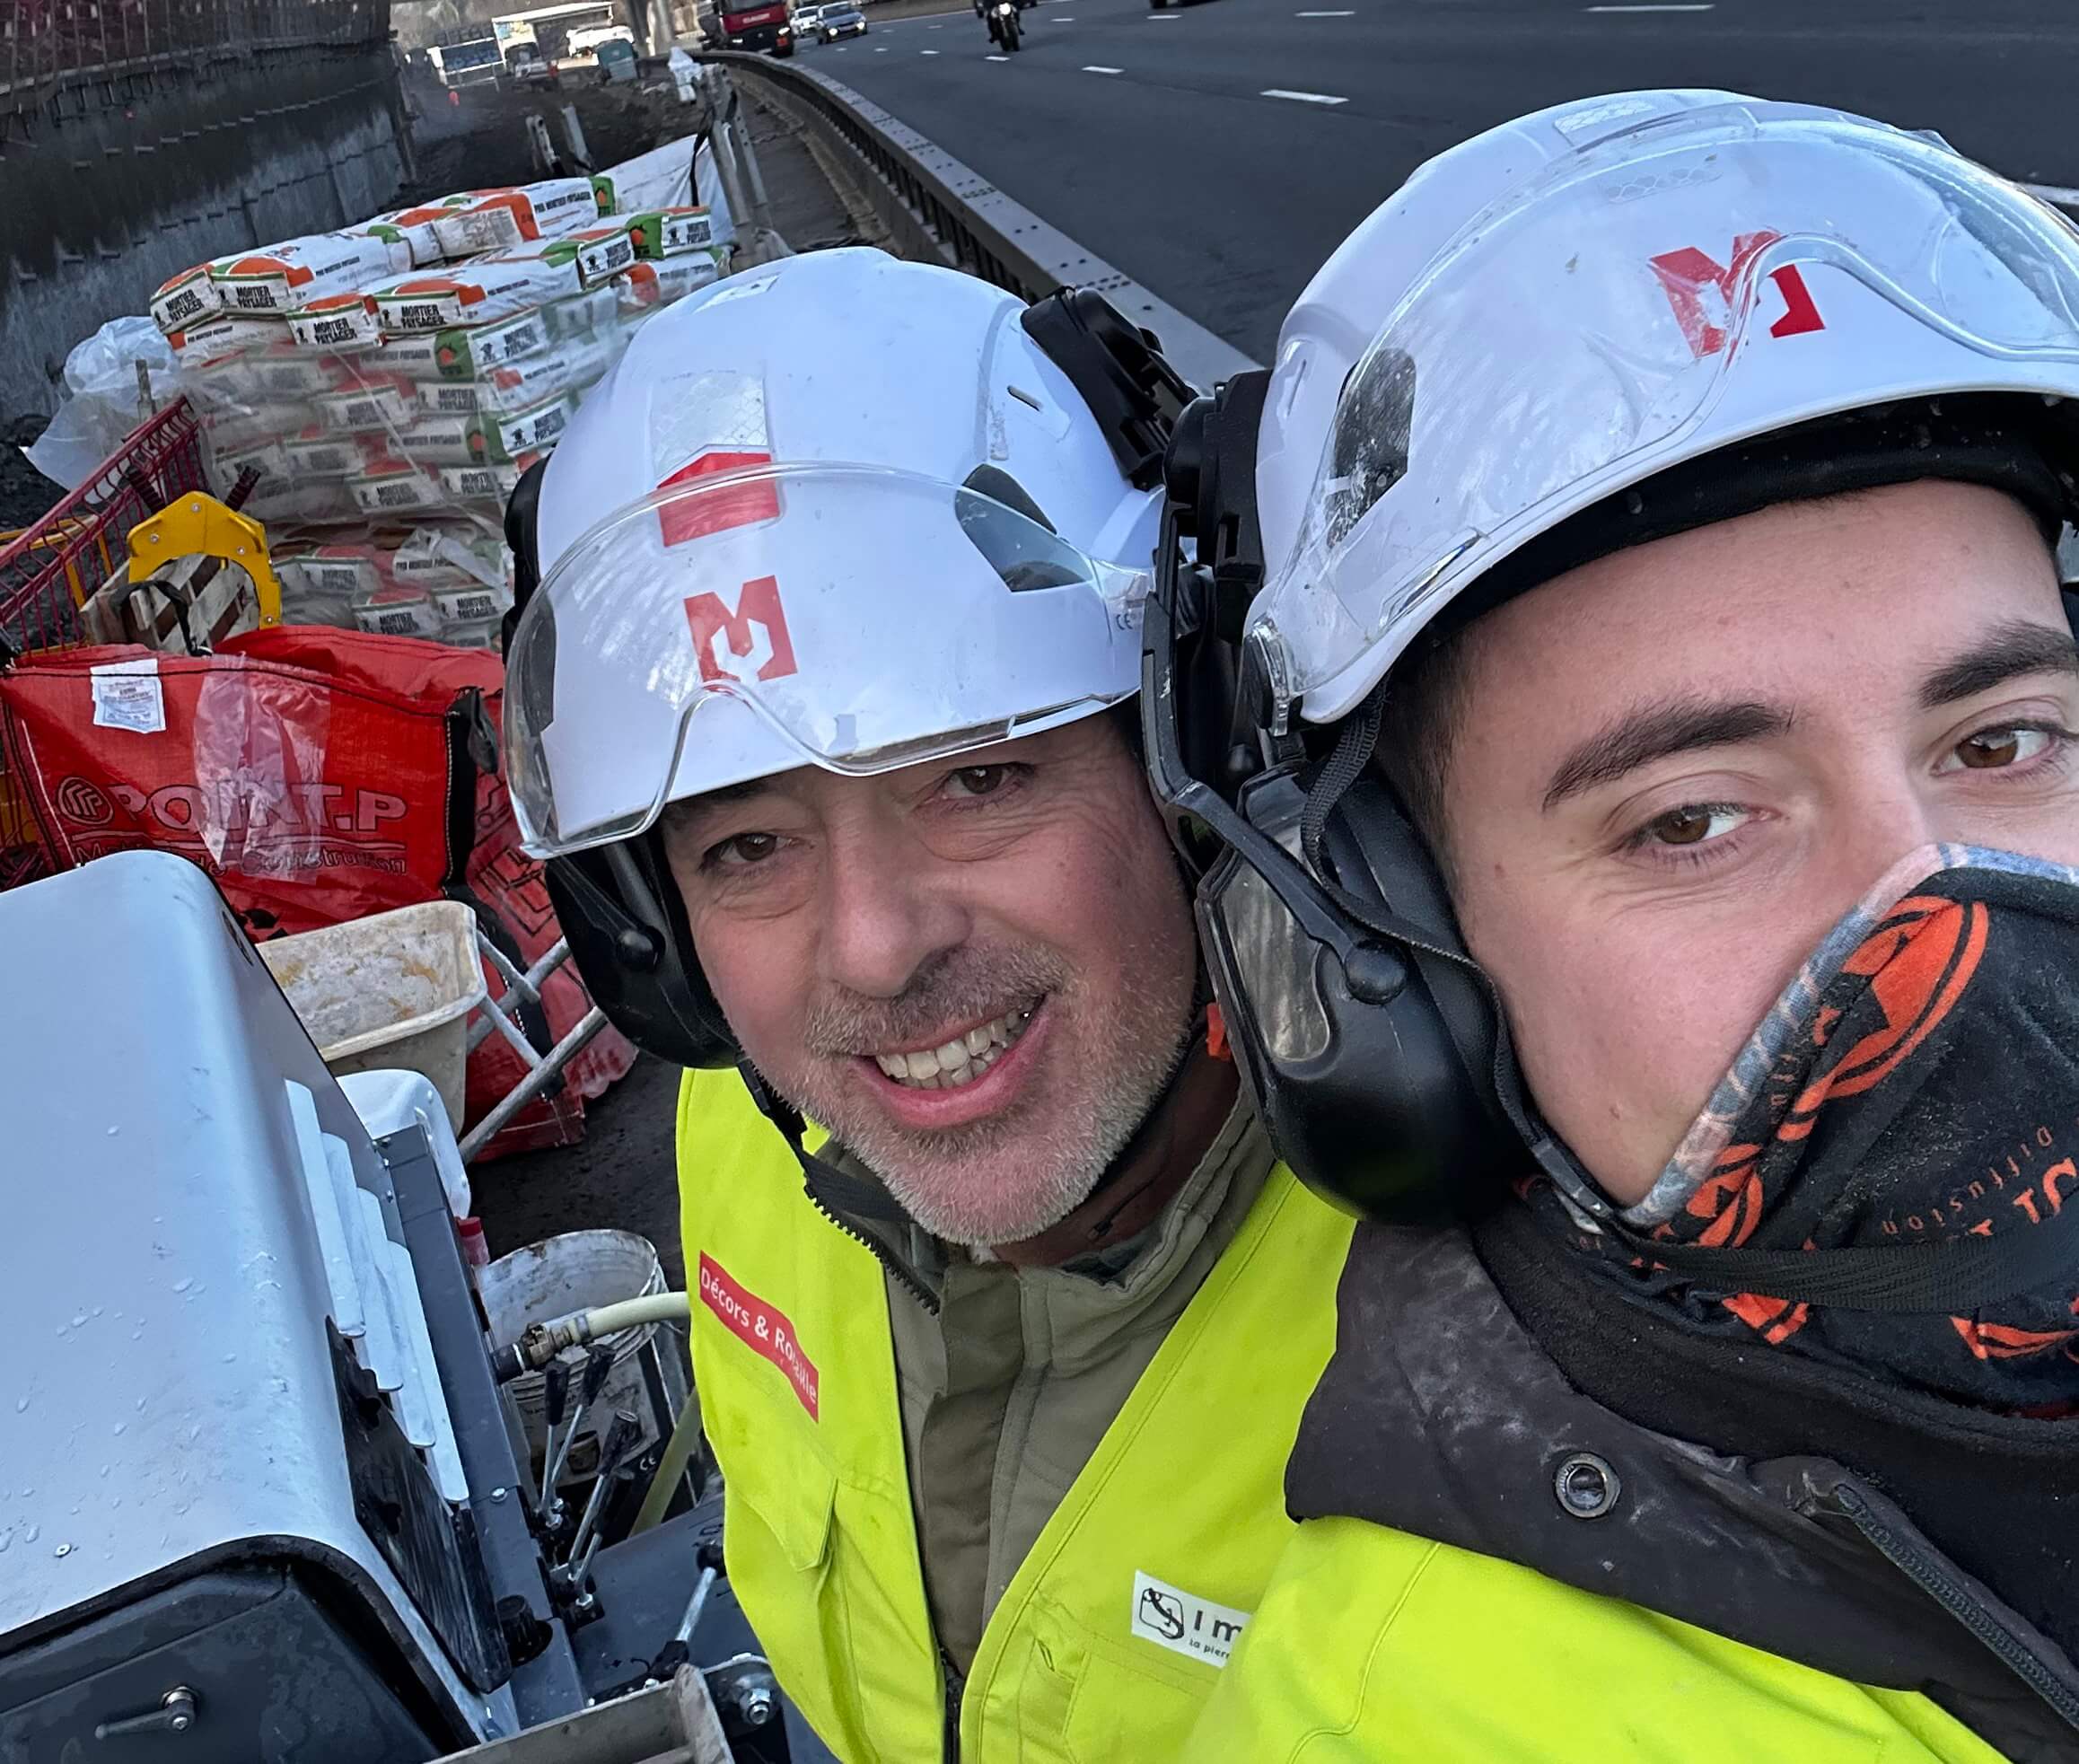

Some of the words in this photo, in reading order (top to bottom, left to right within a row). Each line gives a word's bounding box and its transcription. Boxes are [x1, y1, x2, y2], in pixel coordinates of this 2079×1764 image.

[165, 289, 197, 311] MORTIER
[236, 285, 271, 300] MORTIER
[168, 298, 206, 322] PAYSAGER
[236, 296, 276, 309] PAYSAGER
[401, 303, 440, 318] MORTIER
[313, 318, 351, 334] MORTIER
[401, 315, 448, 329] PAYSAGER
[314, 329, 358, 345] PAYSAGER
[438, 388, 476, 399] MORTIER
[379, 611, 413, 627] MORTIER
[1116, 614, 1133, 630] CE
[700, 1267, 750, 1328] Décors
[754, 1314, 769, 1341] &
[775, 1326, 817, 1405] Roaille
